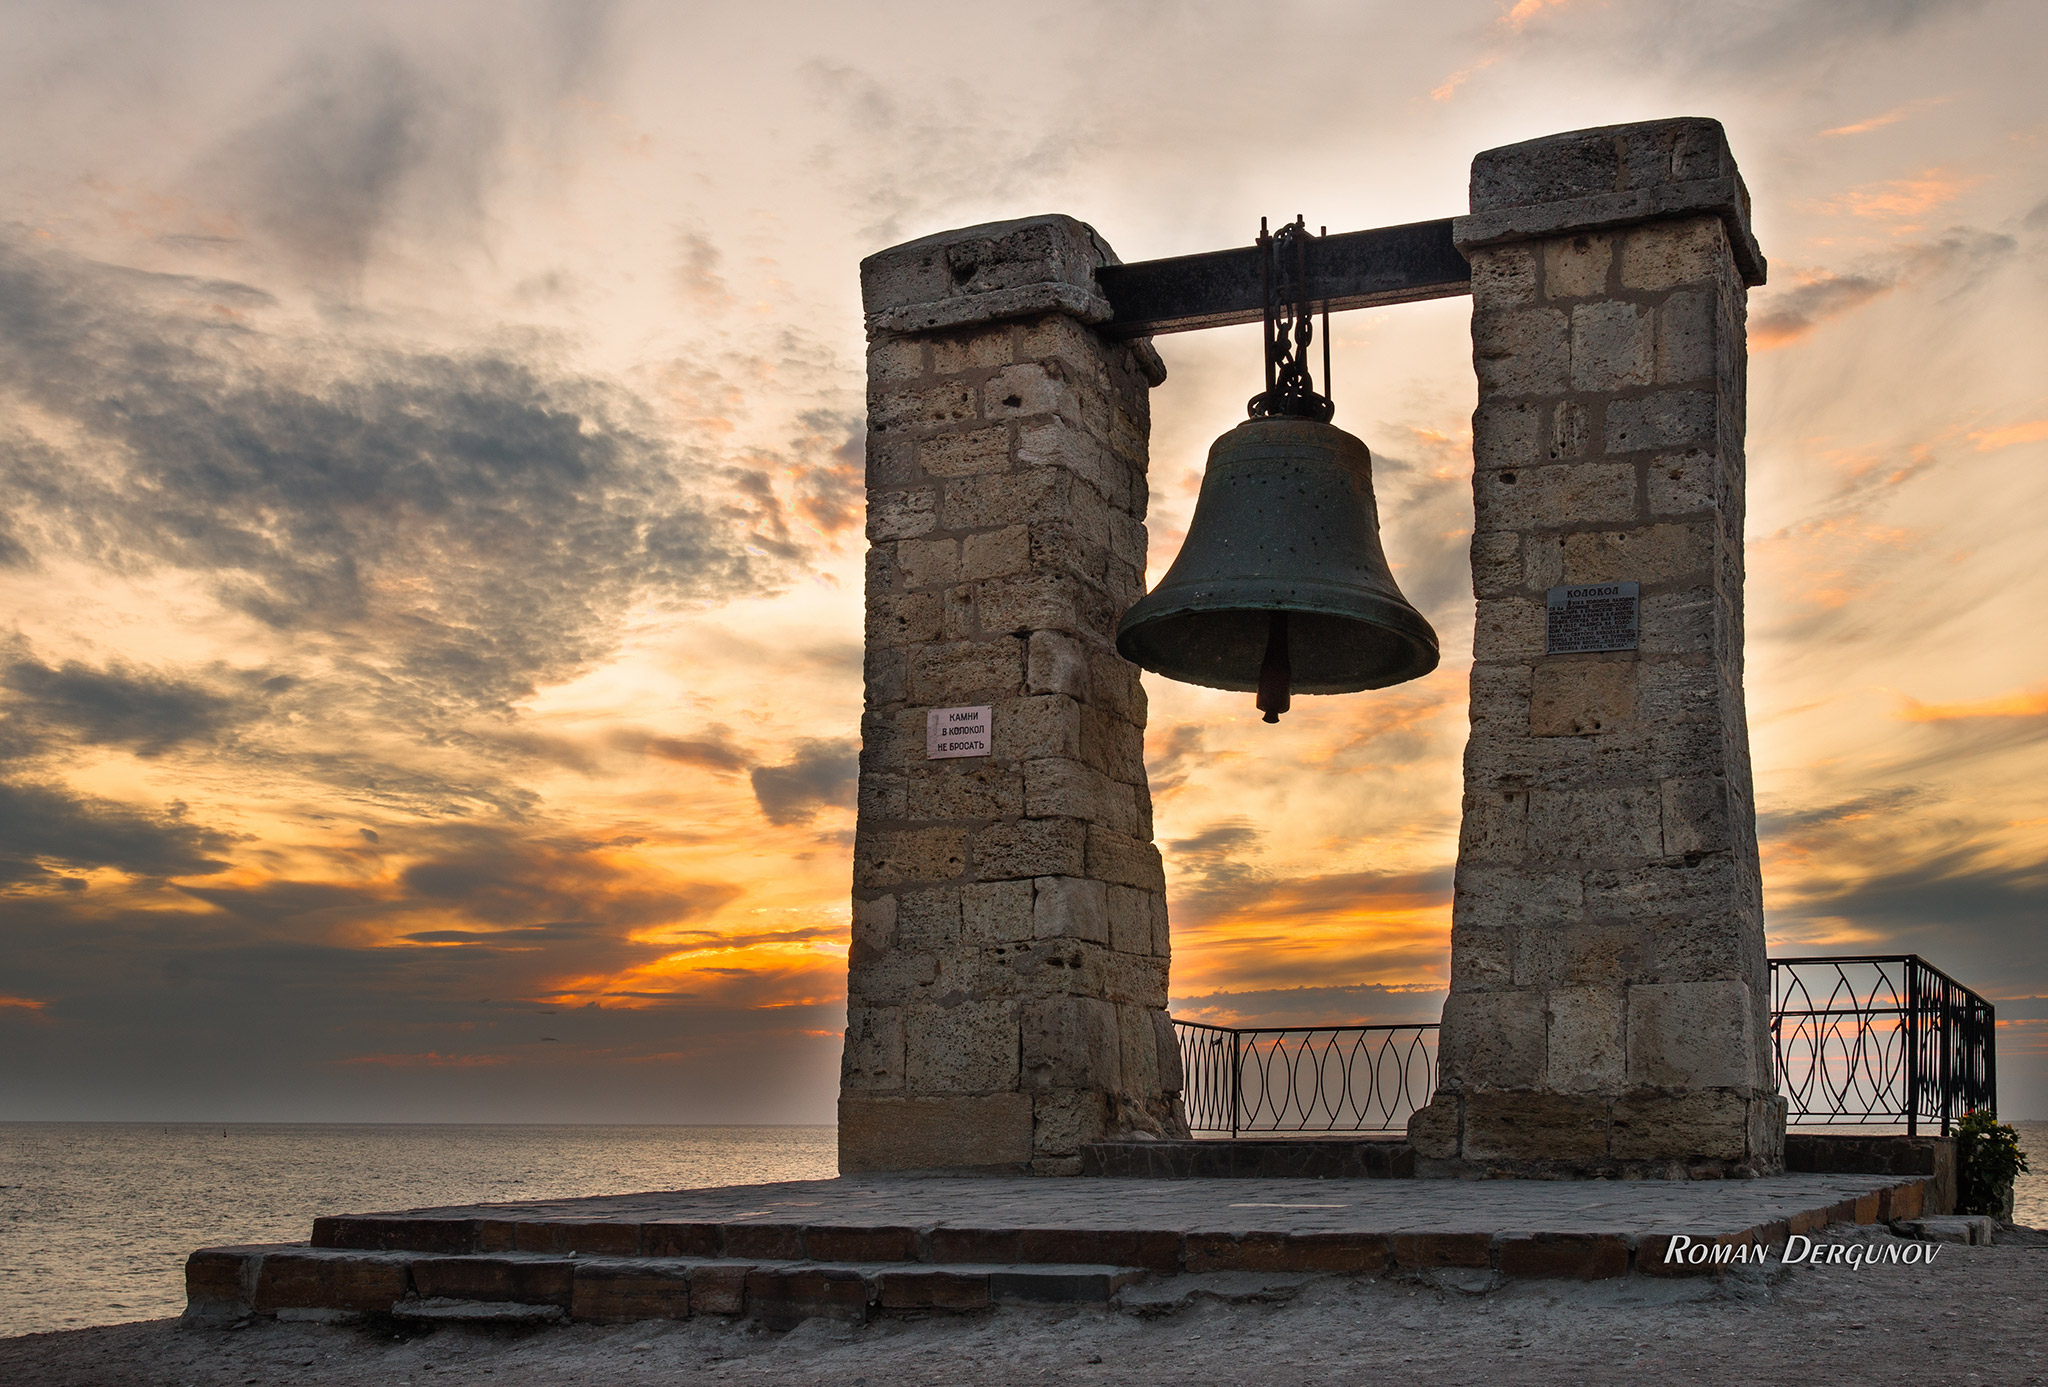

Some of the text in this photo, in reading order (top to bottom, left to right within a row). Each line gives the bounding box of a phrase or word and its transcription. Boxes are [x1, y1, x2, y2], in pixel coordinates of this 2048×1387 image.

[1567, 587, 1619, 598] КОЛОКОЛ
[949, 712, 979, 722] КАМНИ
[942, 725, 985, 736] В КОЛОКОЛ
[937, 741, 985, 752] НЕ БРОСАТЬ
